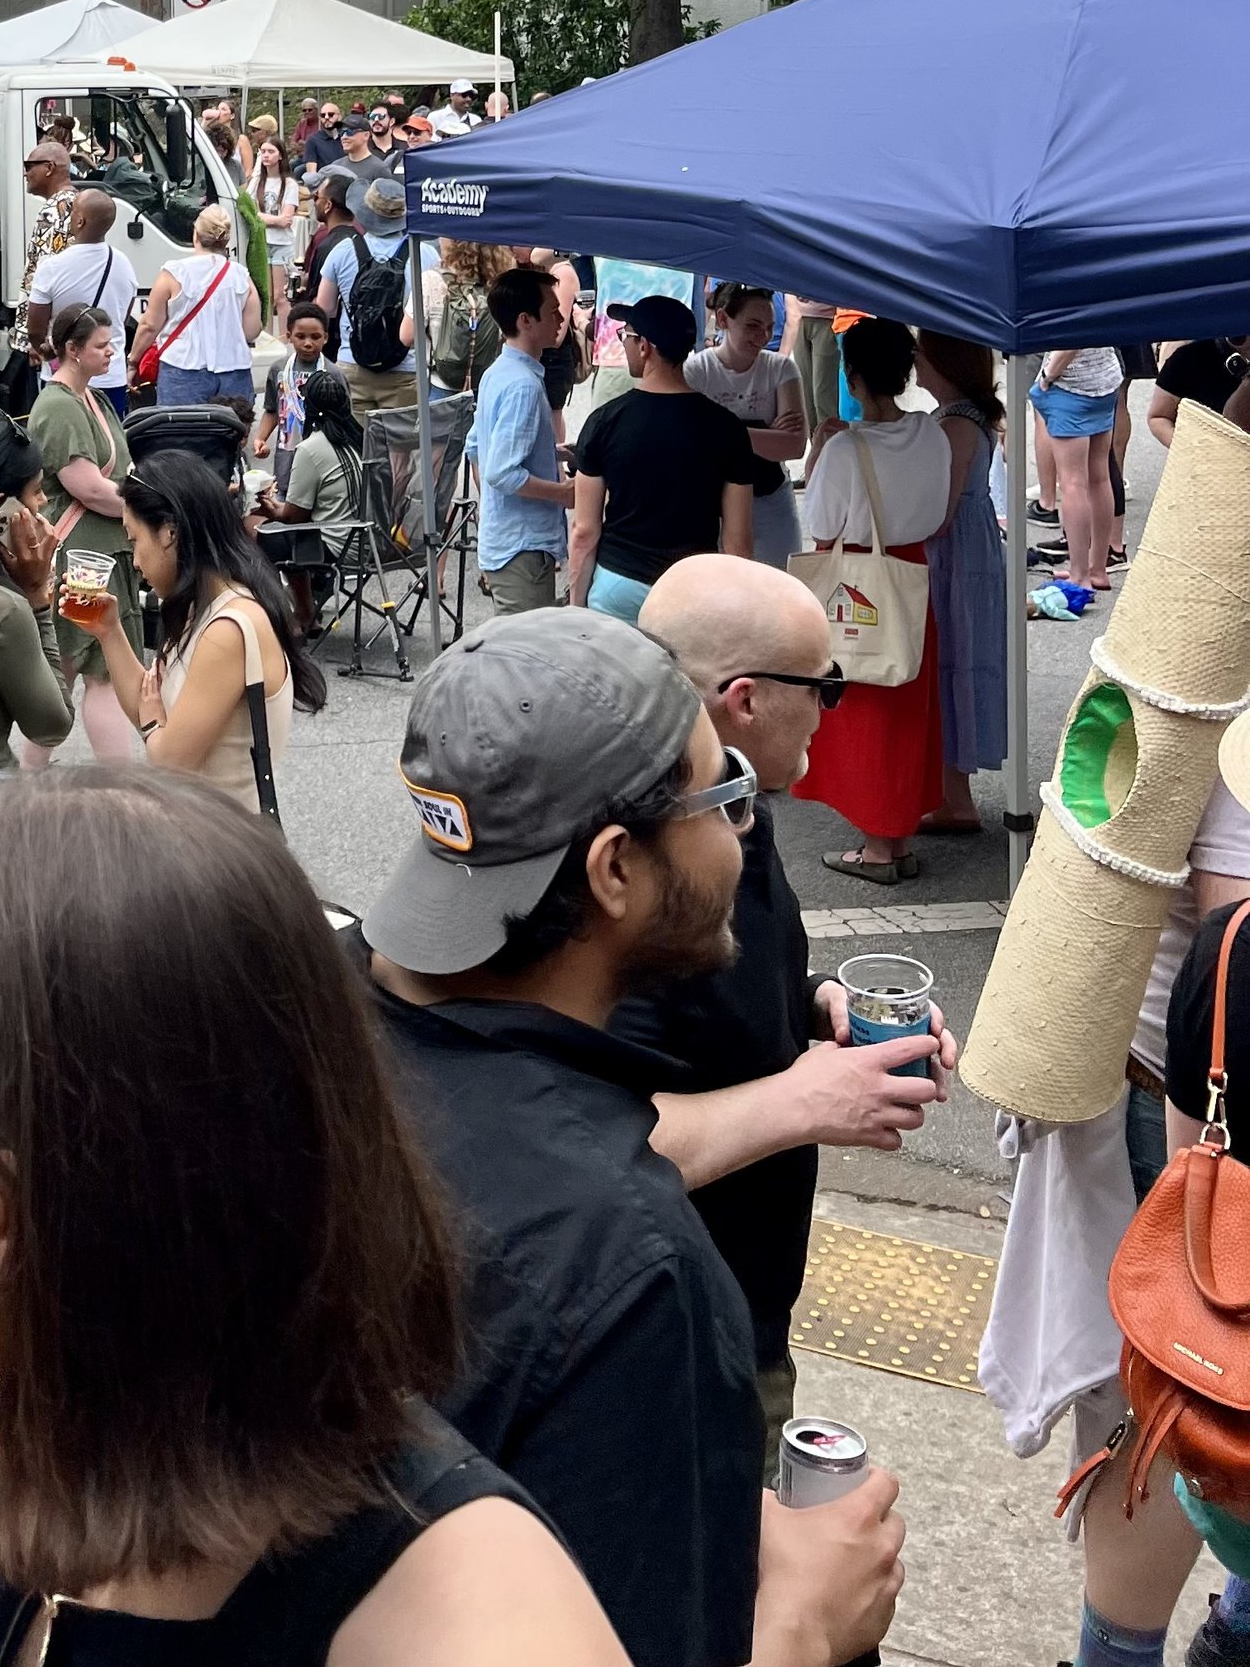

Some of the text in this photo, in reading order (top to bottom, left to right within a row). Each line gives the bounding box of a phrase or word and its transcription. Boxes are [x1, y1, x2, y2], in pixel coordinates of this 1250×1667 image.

[421, 176, 488, 214] Academy
[1172, 1341, 1225, 1376] MICHAEL KORS
